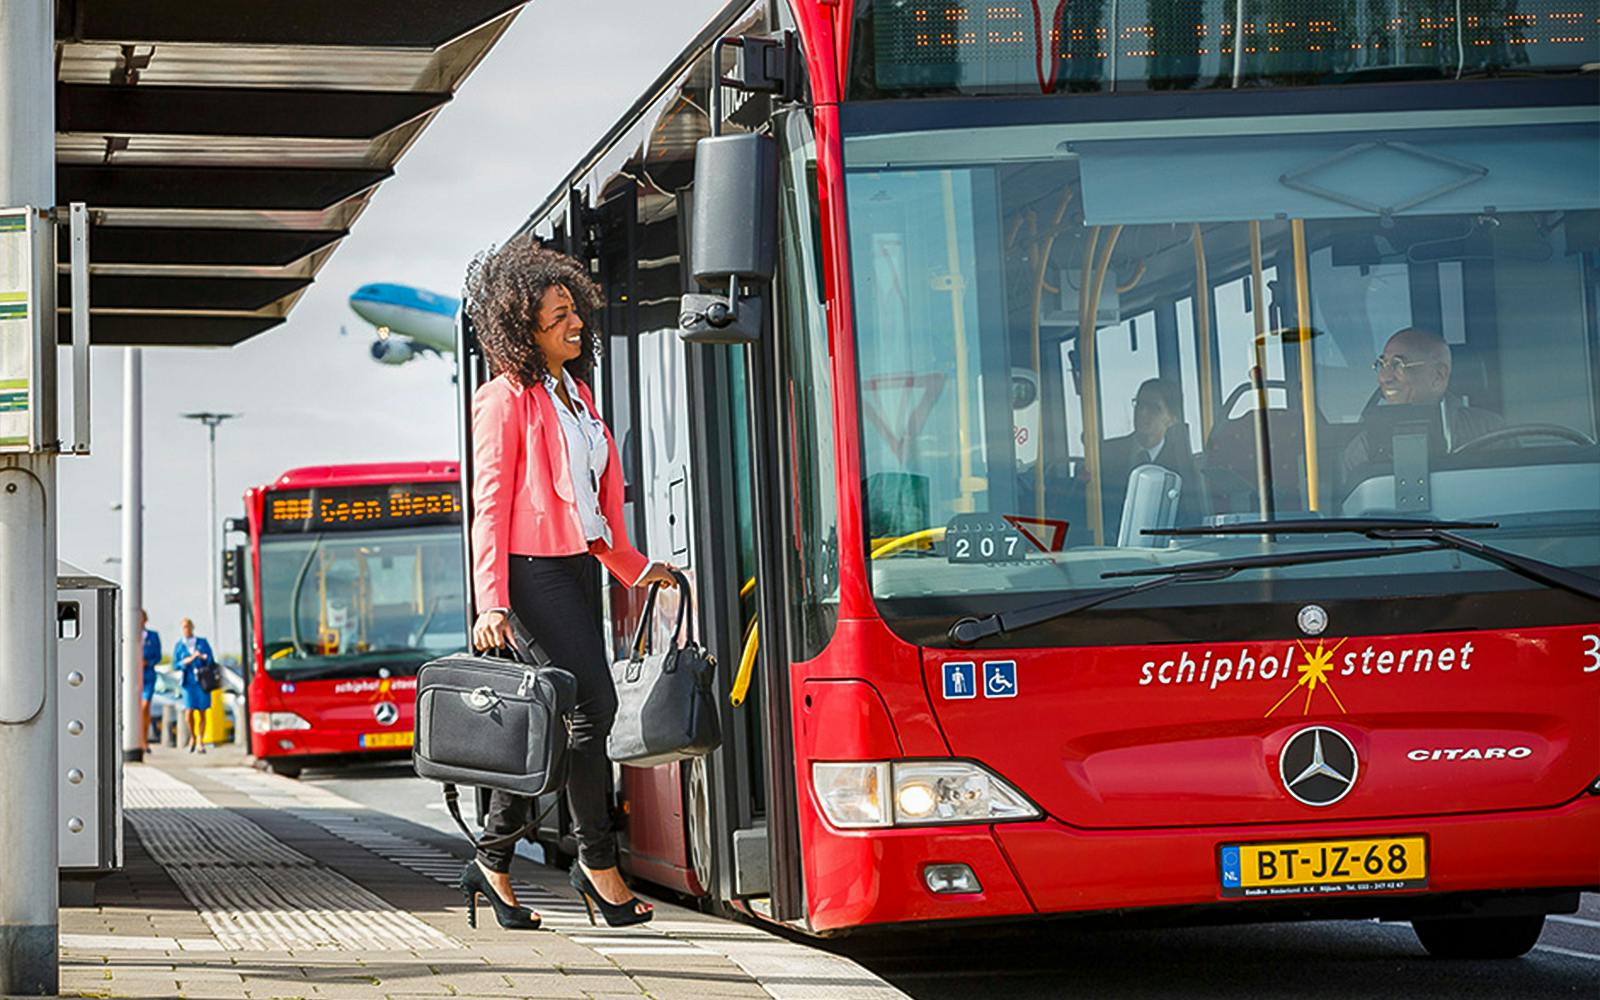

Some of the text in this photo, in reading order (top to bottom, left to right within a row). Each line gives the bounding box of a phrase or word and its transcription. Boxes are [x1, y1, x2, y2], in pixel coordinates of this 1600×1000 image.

[955, 536, 1018, 558] 207
[1138, 641, 1475, 690] schiphol sternet
[1407, 746, 1533, 761] CITARO
[1257, 844, 1408, 881] BT-JZ-68
[1224, 871, 1238, 881] NL
